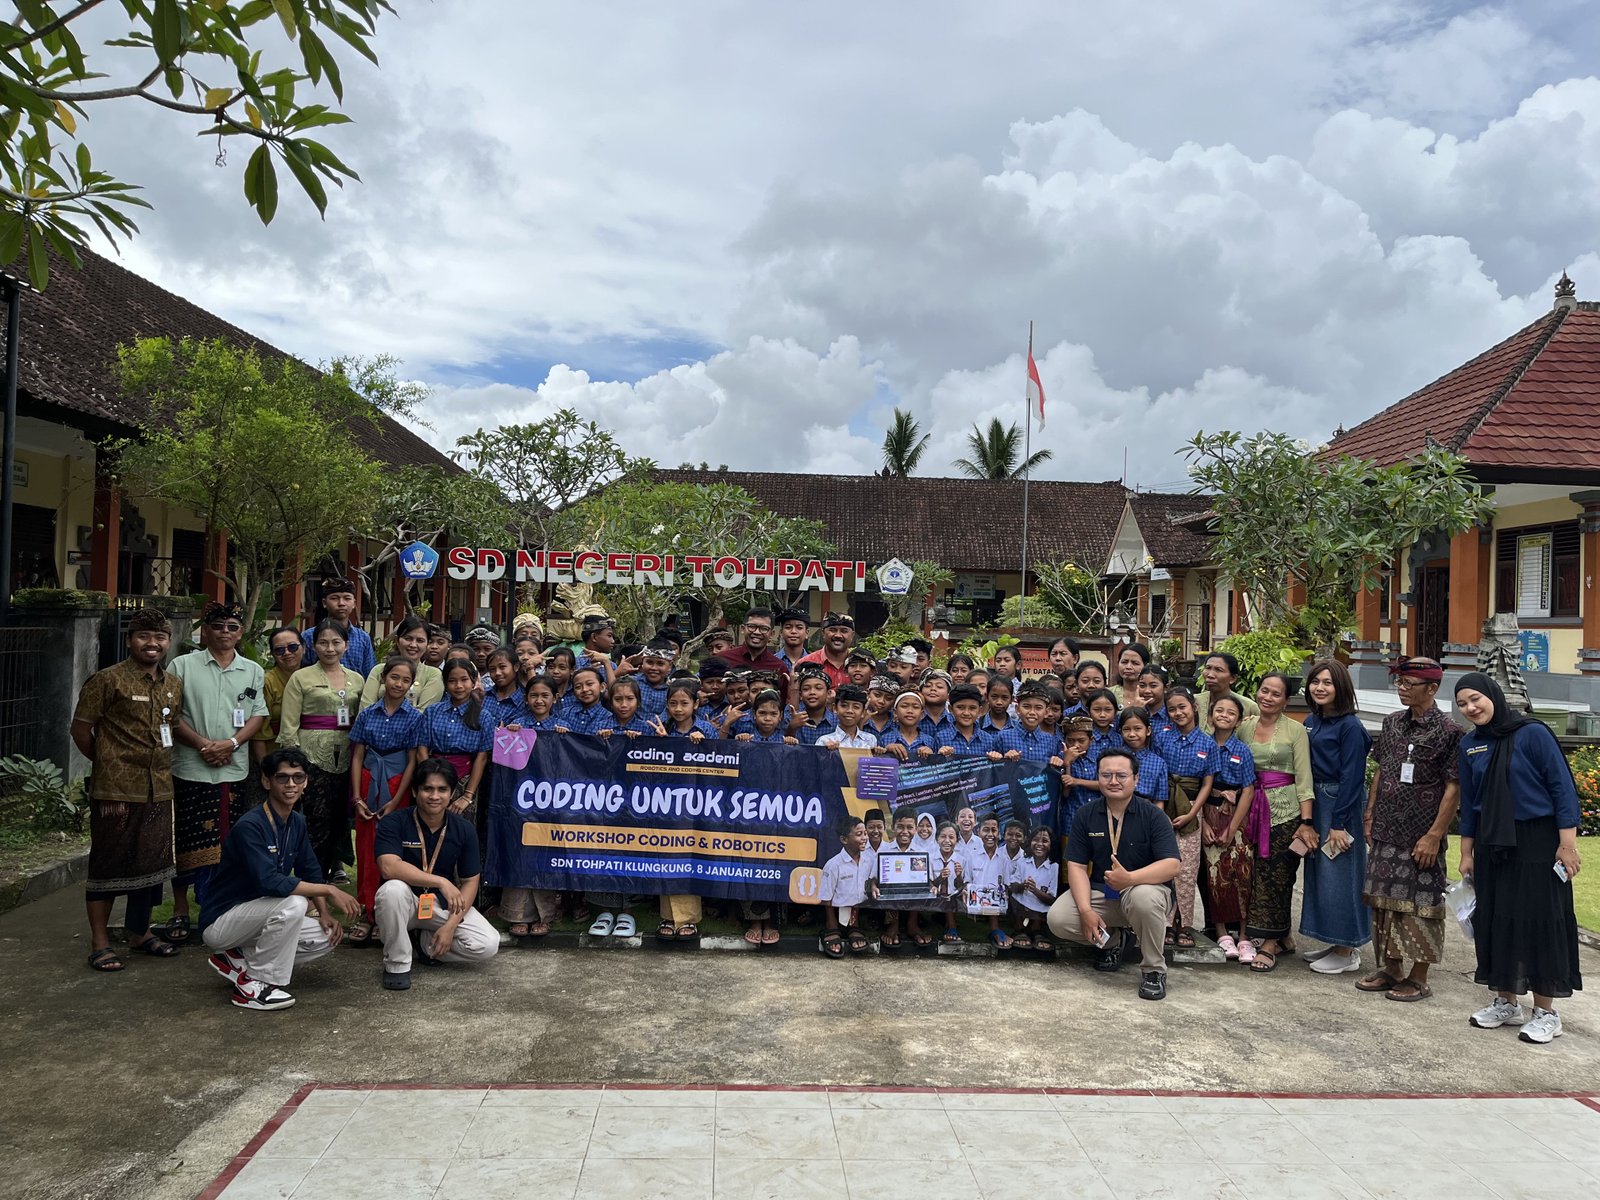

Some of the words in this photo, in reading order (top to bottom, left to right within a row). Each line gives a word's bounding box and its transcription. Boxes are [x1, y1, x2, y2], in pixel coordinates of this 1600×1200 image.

[447, 546, 506, 582] SD
[515, 549, 674, 588] NEGERI
[685, 555, 866, 593] TOHPATI
[683, 751, 740, 765] akademi
[517, 779, 625, 813] CODING
[631, 785, 724, 818] UNTUK
[729, 790, 823, 825] SEMUA
[550, 829, 635, 845] WORKSHOP
[638, 834, 696, 847] CODING
[698, 836, 708, 849] &
[712, 838, 786, 853] ROBOTICS
[550, 857, 573, 868] SDN
[575, 859, 623, 871] TOHPATI
[625, 861, 694, 874] KLUNGKUNG,
[696, 864, 703, 874] 8
[705, 866, 753, 878] JANUARI
[754, 868, 781, 880] 2026
